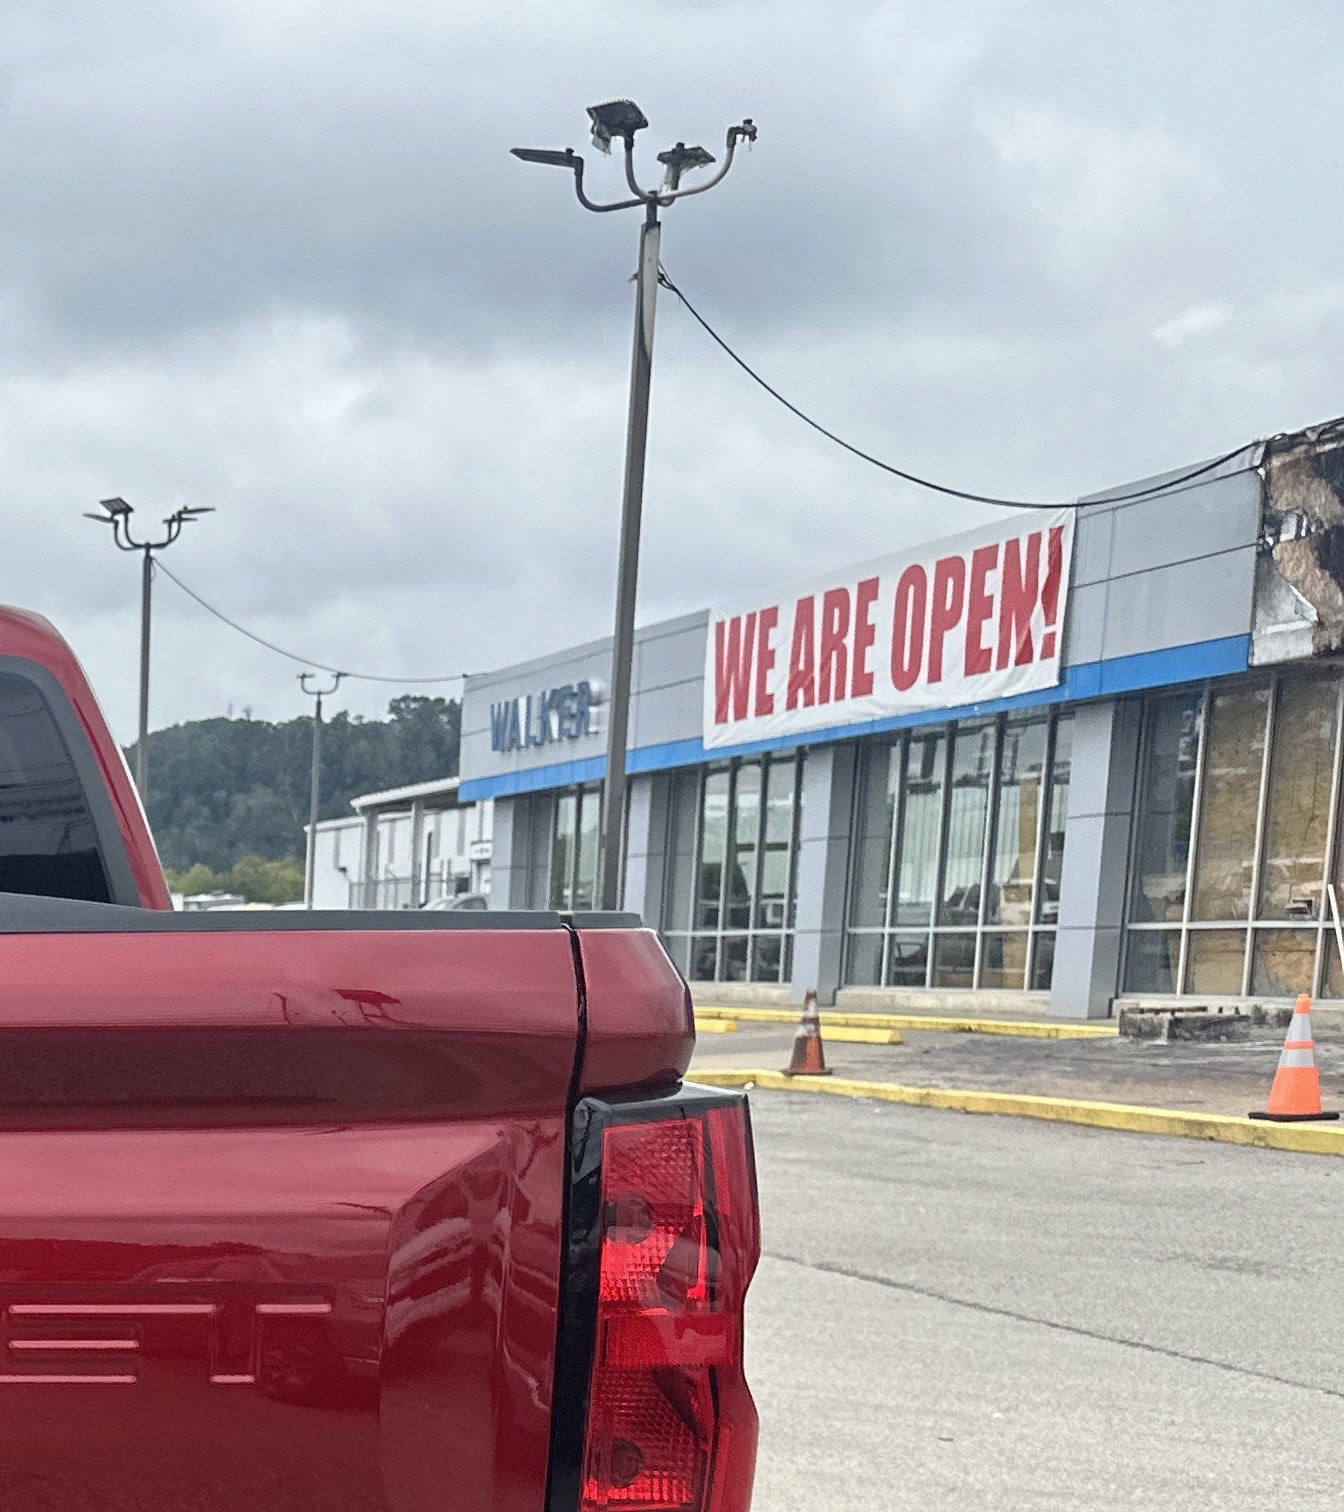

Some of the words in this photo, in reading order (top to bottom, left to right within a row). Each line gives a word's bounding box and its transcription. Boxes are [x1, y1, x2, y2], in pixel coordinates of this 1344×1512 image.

[713, 606, 779, 724] WE
[786, 577, 879, 711] ARE
[890, 526, 1064, 692] OPEN!
[490, 681, 593, 752] WALKER
